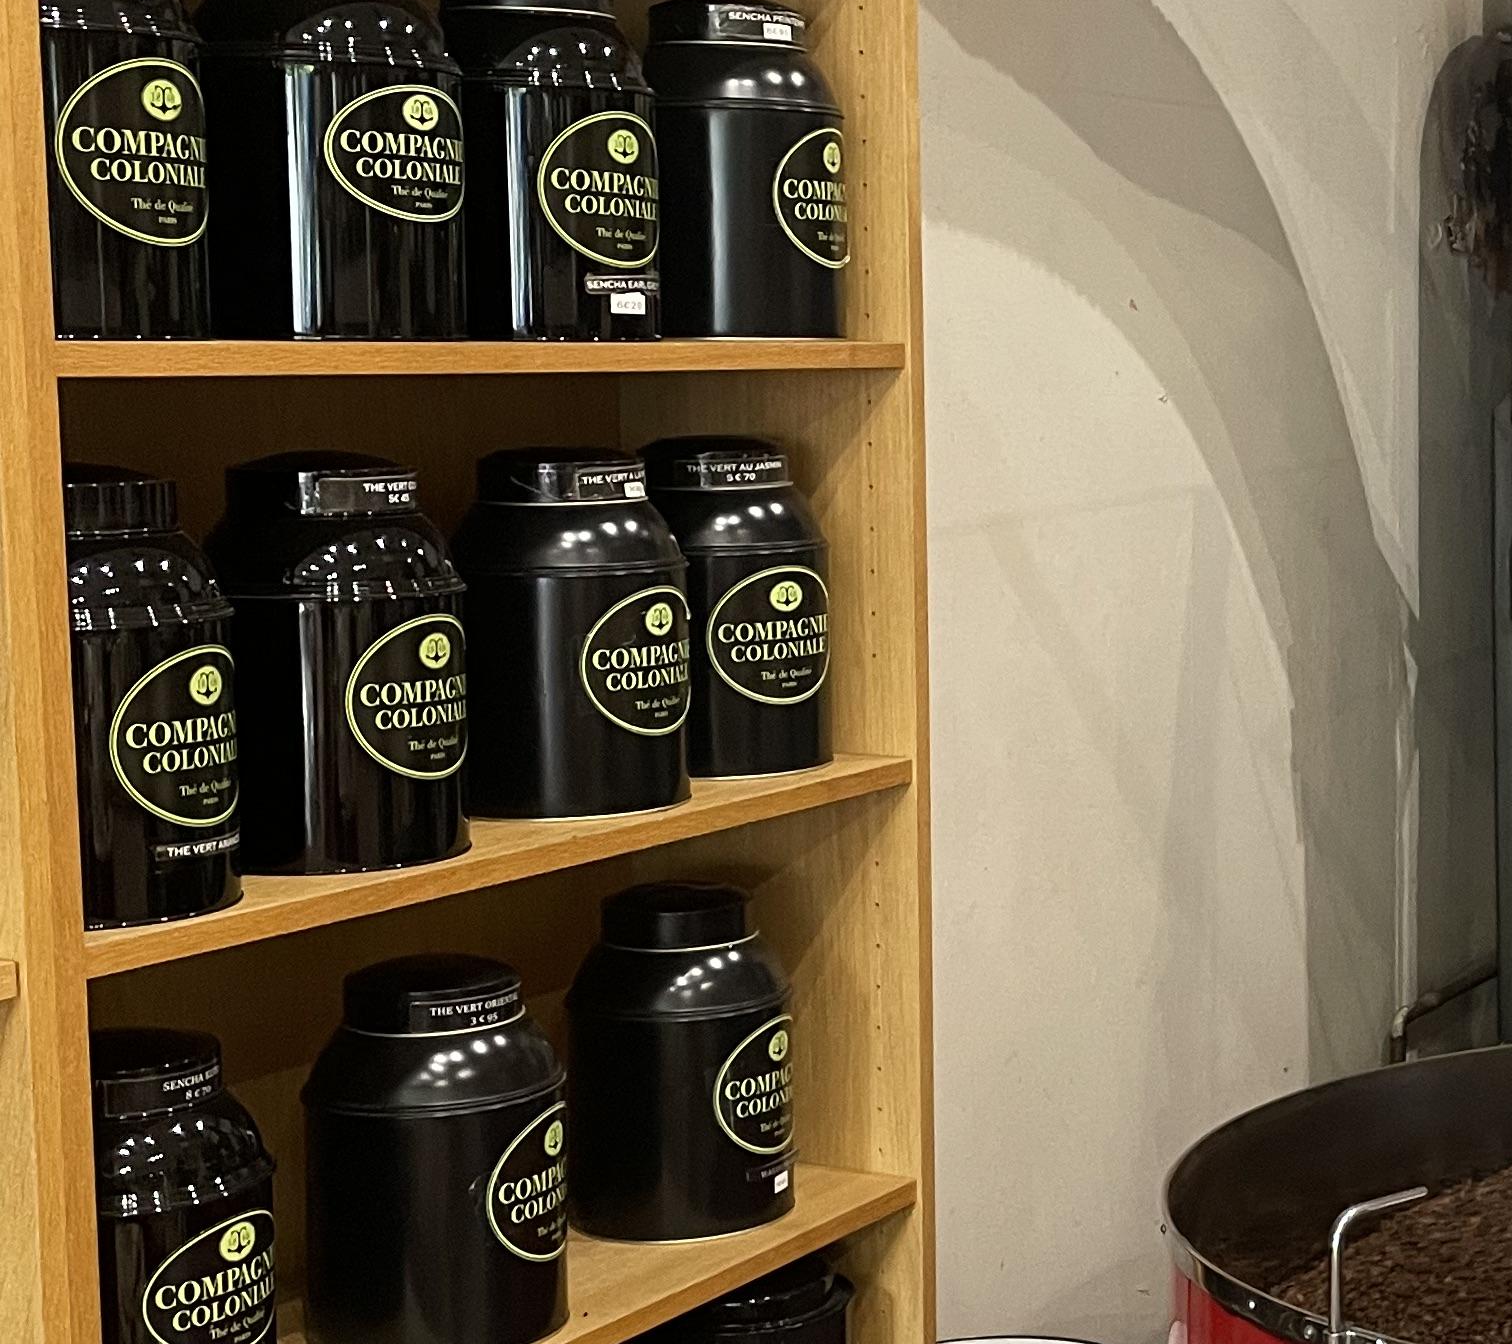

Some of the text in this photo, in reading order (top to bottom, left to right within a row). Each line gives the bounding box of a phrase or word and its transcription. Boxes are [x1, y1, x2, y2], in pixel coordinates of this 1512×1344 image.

[728, 11, 771, 22] SENCHA
[586, 280, 627, 289] SENCHA
[687, 464, 708, 473] THE
[709, 463, 737, 472] VERT
[739, 463, 753, 471] AU
[581, 475, 604, 484] THE
[605, 472, 628, 483] VERT
[363, 482, 385, 492] THE
[730, 635, 825, 663] COLONIALE
[167, 841, 217, 857] THE VERT
[429, 1006, 453, 1016] THE
[456, 1002, 483, 1014] VERT
[163, 1073, 204, 1091] SENCHA
